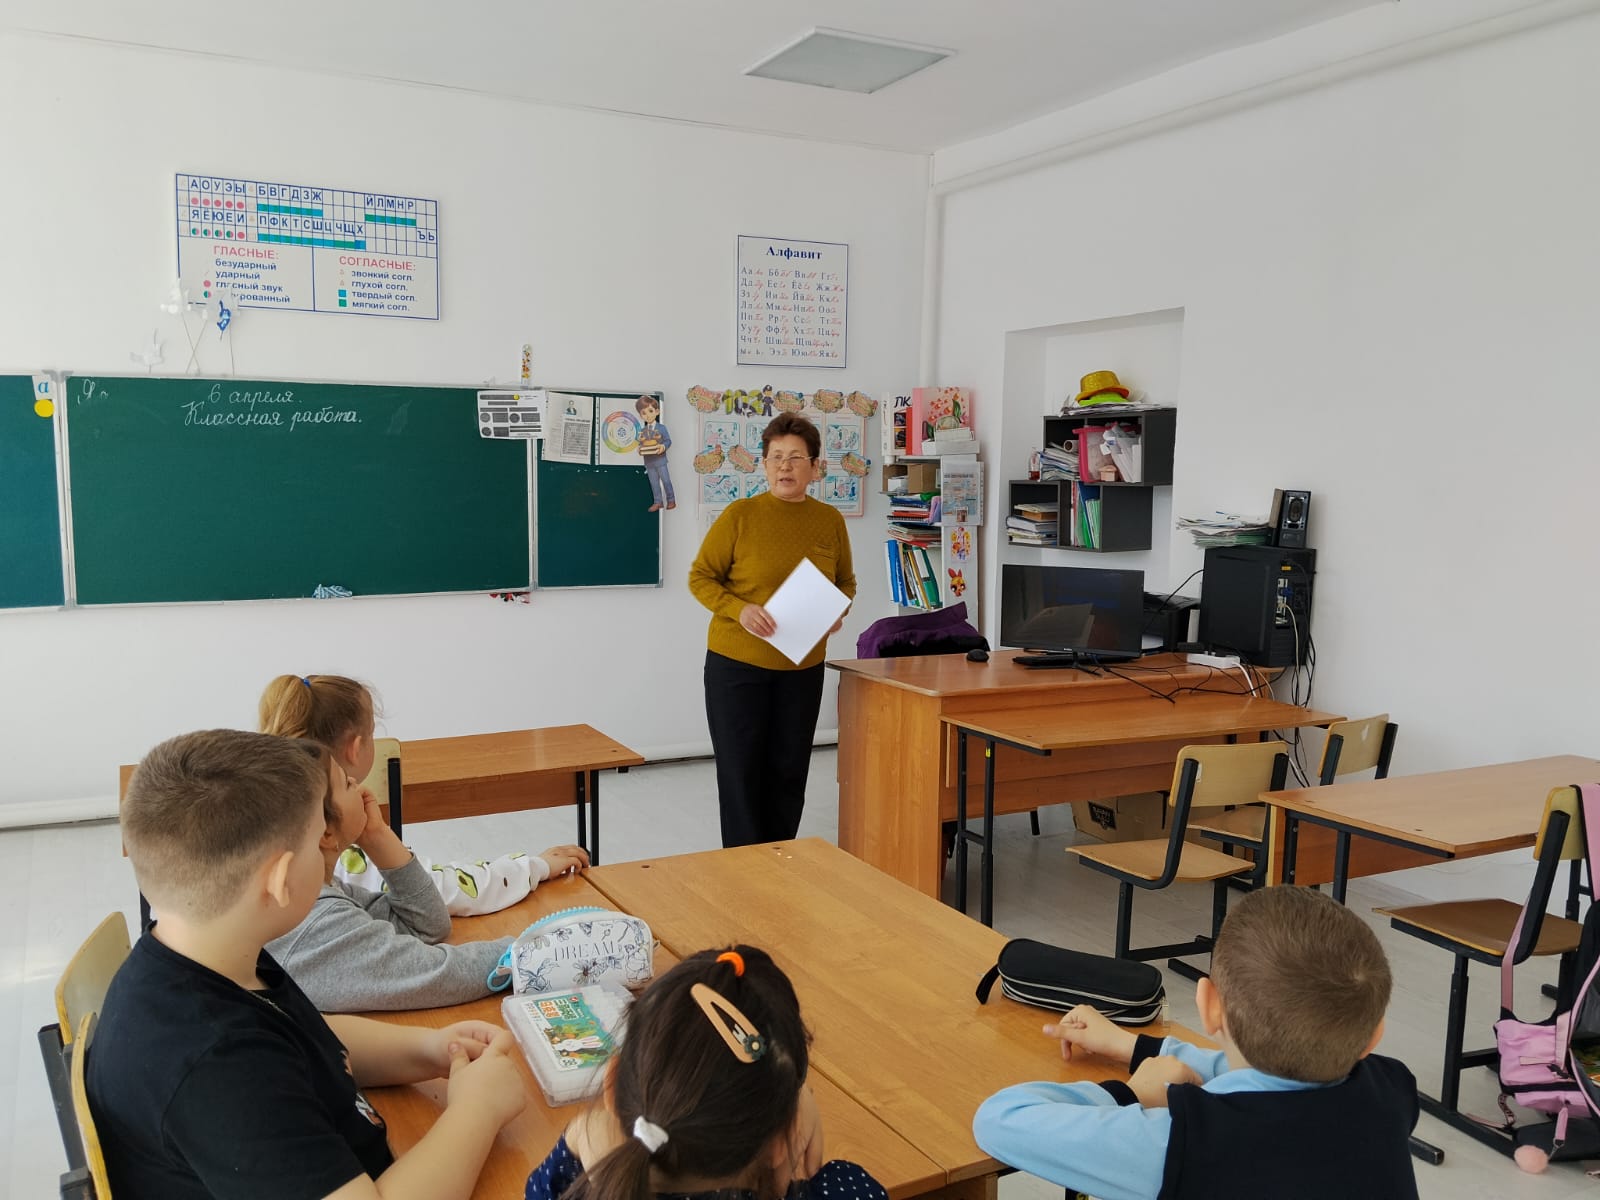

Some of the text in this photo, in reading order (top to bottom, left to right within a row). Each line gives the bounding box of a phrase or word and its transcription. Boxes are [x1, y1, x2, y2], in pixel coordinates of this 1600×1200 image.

[213, 245, 279, 260] ГЛАСНЫЕ:
[766, 246, 822, 260] Алфавит
[215, 258, 277, 271] безударный
[339, 255, 416, 271] СОГЛАСНЫЕ:
[215, 271, 261, 280] ударный
[351, 270, 389, 279] звонкий
[261, 284, 283, 293] звук
[351, 280, 408, 291] глухой согл.
[351, 290, 393, 300] твердый
[352, 301, 410, 312] мягкий согл.
[208, 383, 221, 404] 6
[181, 401, 363, 432] Классная работа.
[554, 940, 614, 962] DREAM
